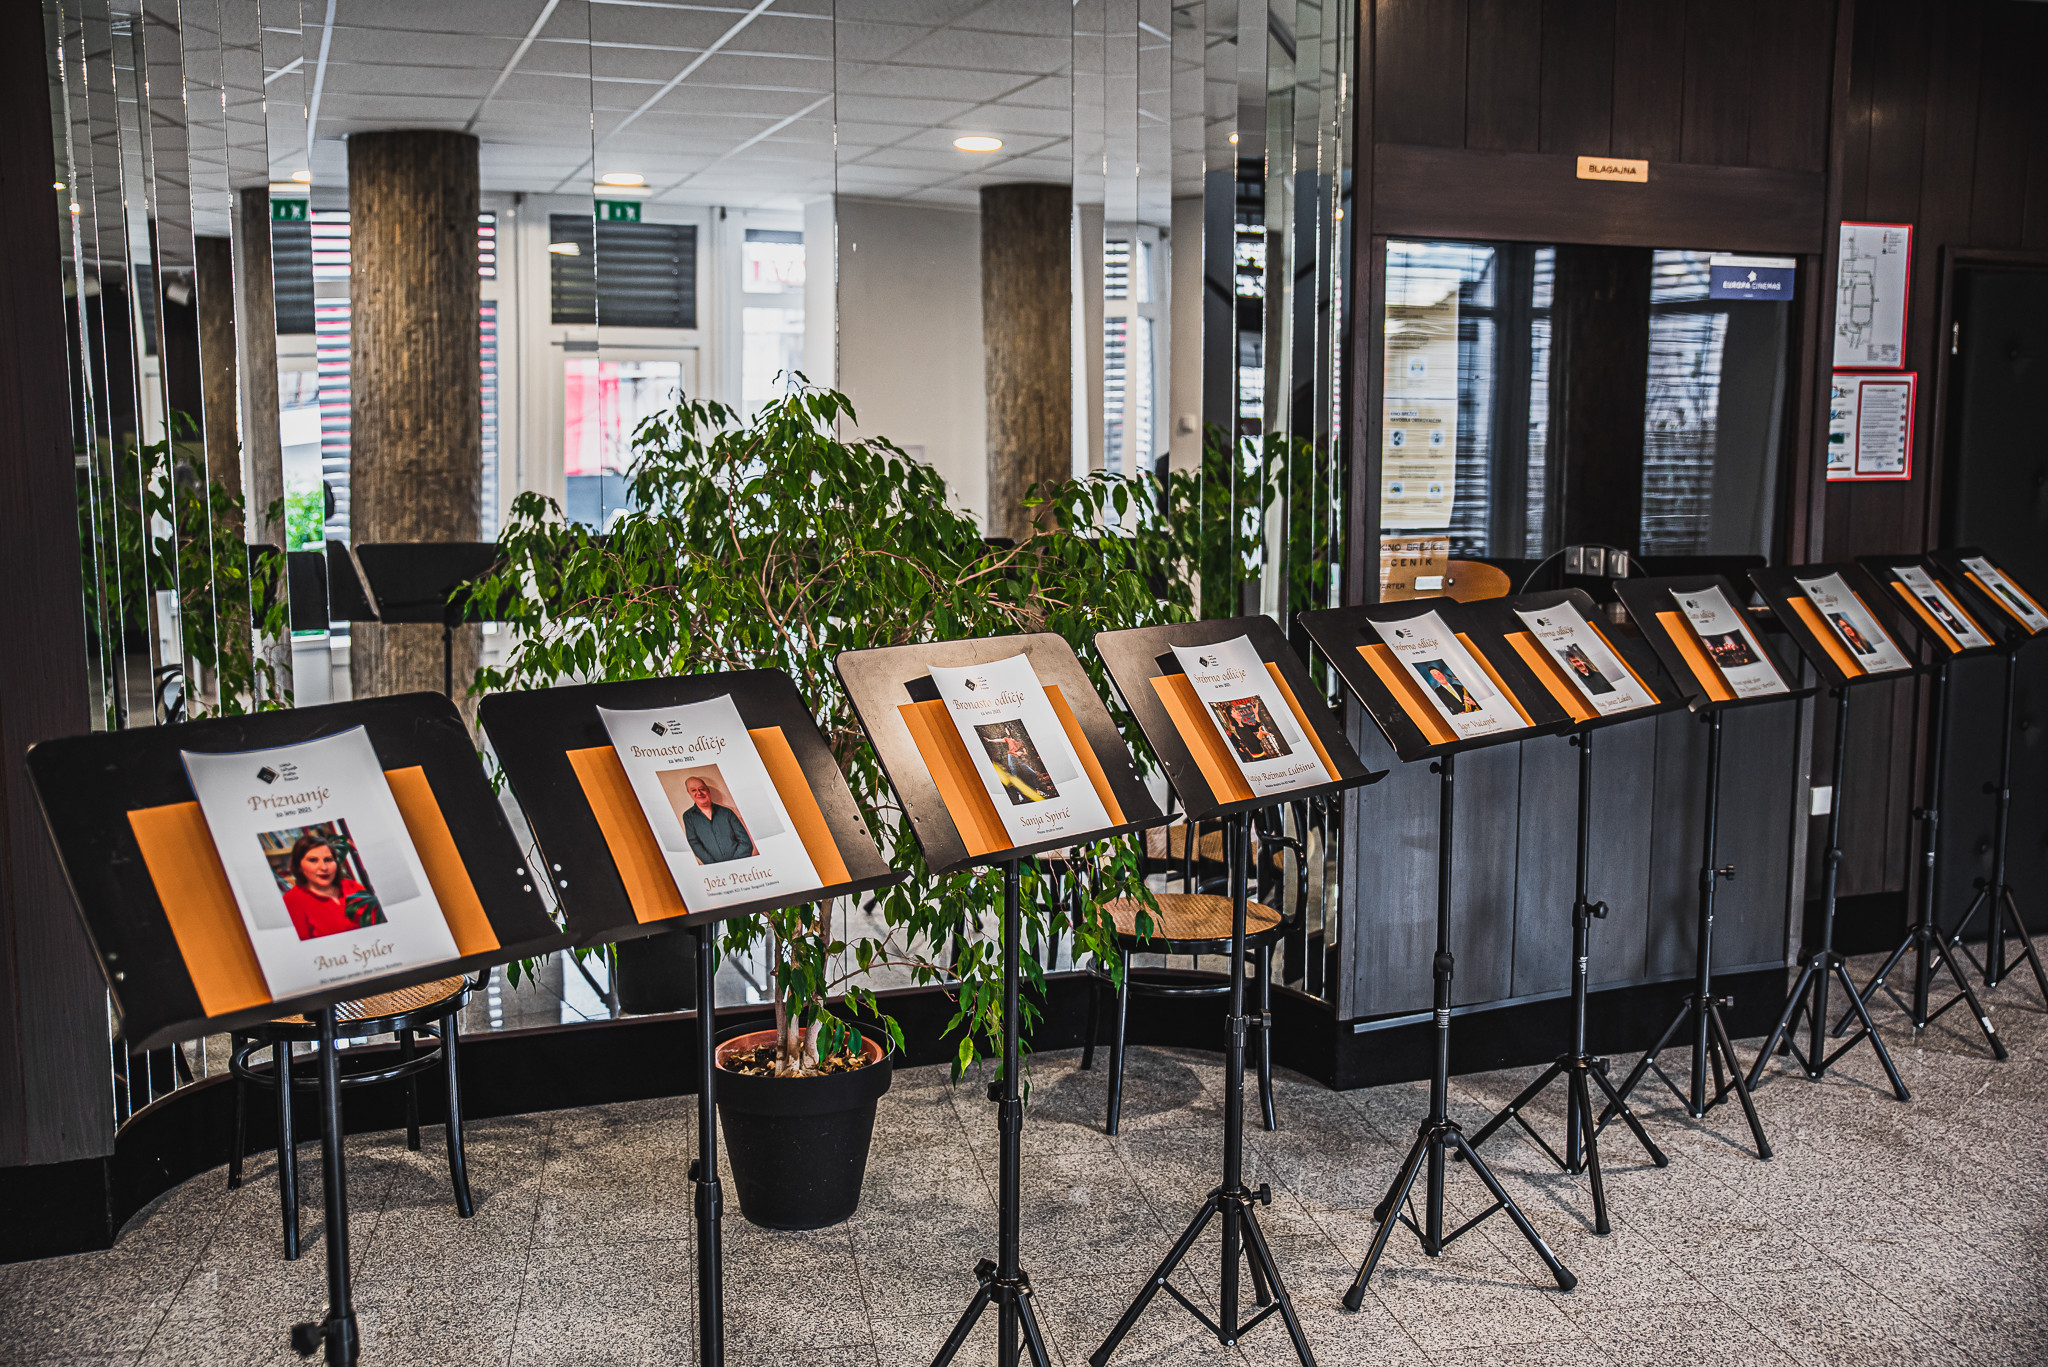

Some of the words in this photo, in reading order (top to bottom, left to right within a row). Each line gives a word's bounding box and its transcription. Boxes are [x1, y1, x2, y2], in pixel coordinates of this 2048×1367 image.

[1588, 164, 1637, 174] BLAGAJNA
[1722, 280, 1751, 289] EUROPA
[1751, 281, 1782, 290] CINEMAS
[1379, 543, 1401, 551] KINO
[1390, 558, 1433, 567] CENIK
[1380, 582, 1406, 590] ARTER
[1221, 667, 1247, 683] odličje
[952, 698, 992, 711] Bronasto
[994, 690, 1026, 709] odličje
[630, 744, 684, 758] Bronasto
[688, 735, 727, 755] odličje
[1287, 760, 1316, 777] Lubšina
[247, 785, 331, 811] Priznanje
[1019, 813, 1045, 830] Sanja
[1044, 806, 1071, 827] Spirić
[703, 874, 727, 892] Jože
[728, 866, 774, 885] Petelinc
[313, 954, 349, 971] Ana
[352, 938, 395, 969] Špiler
